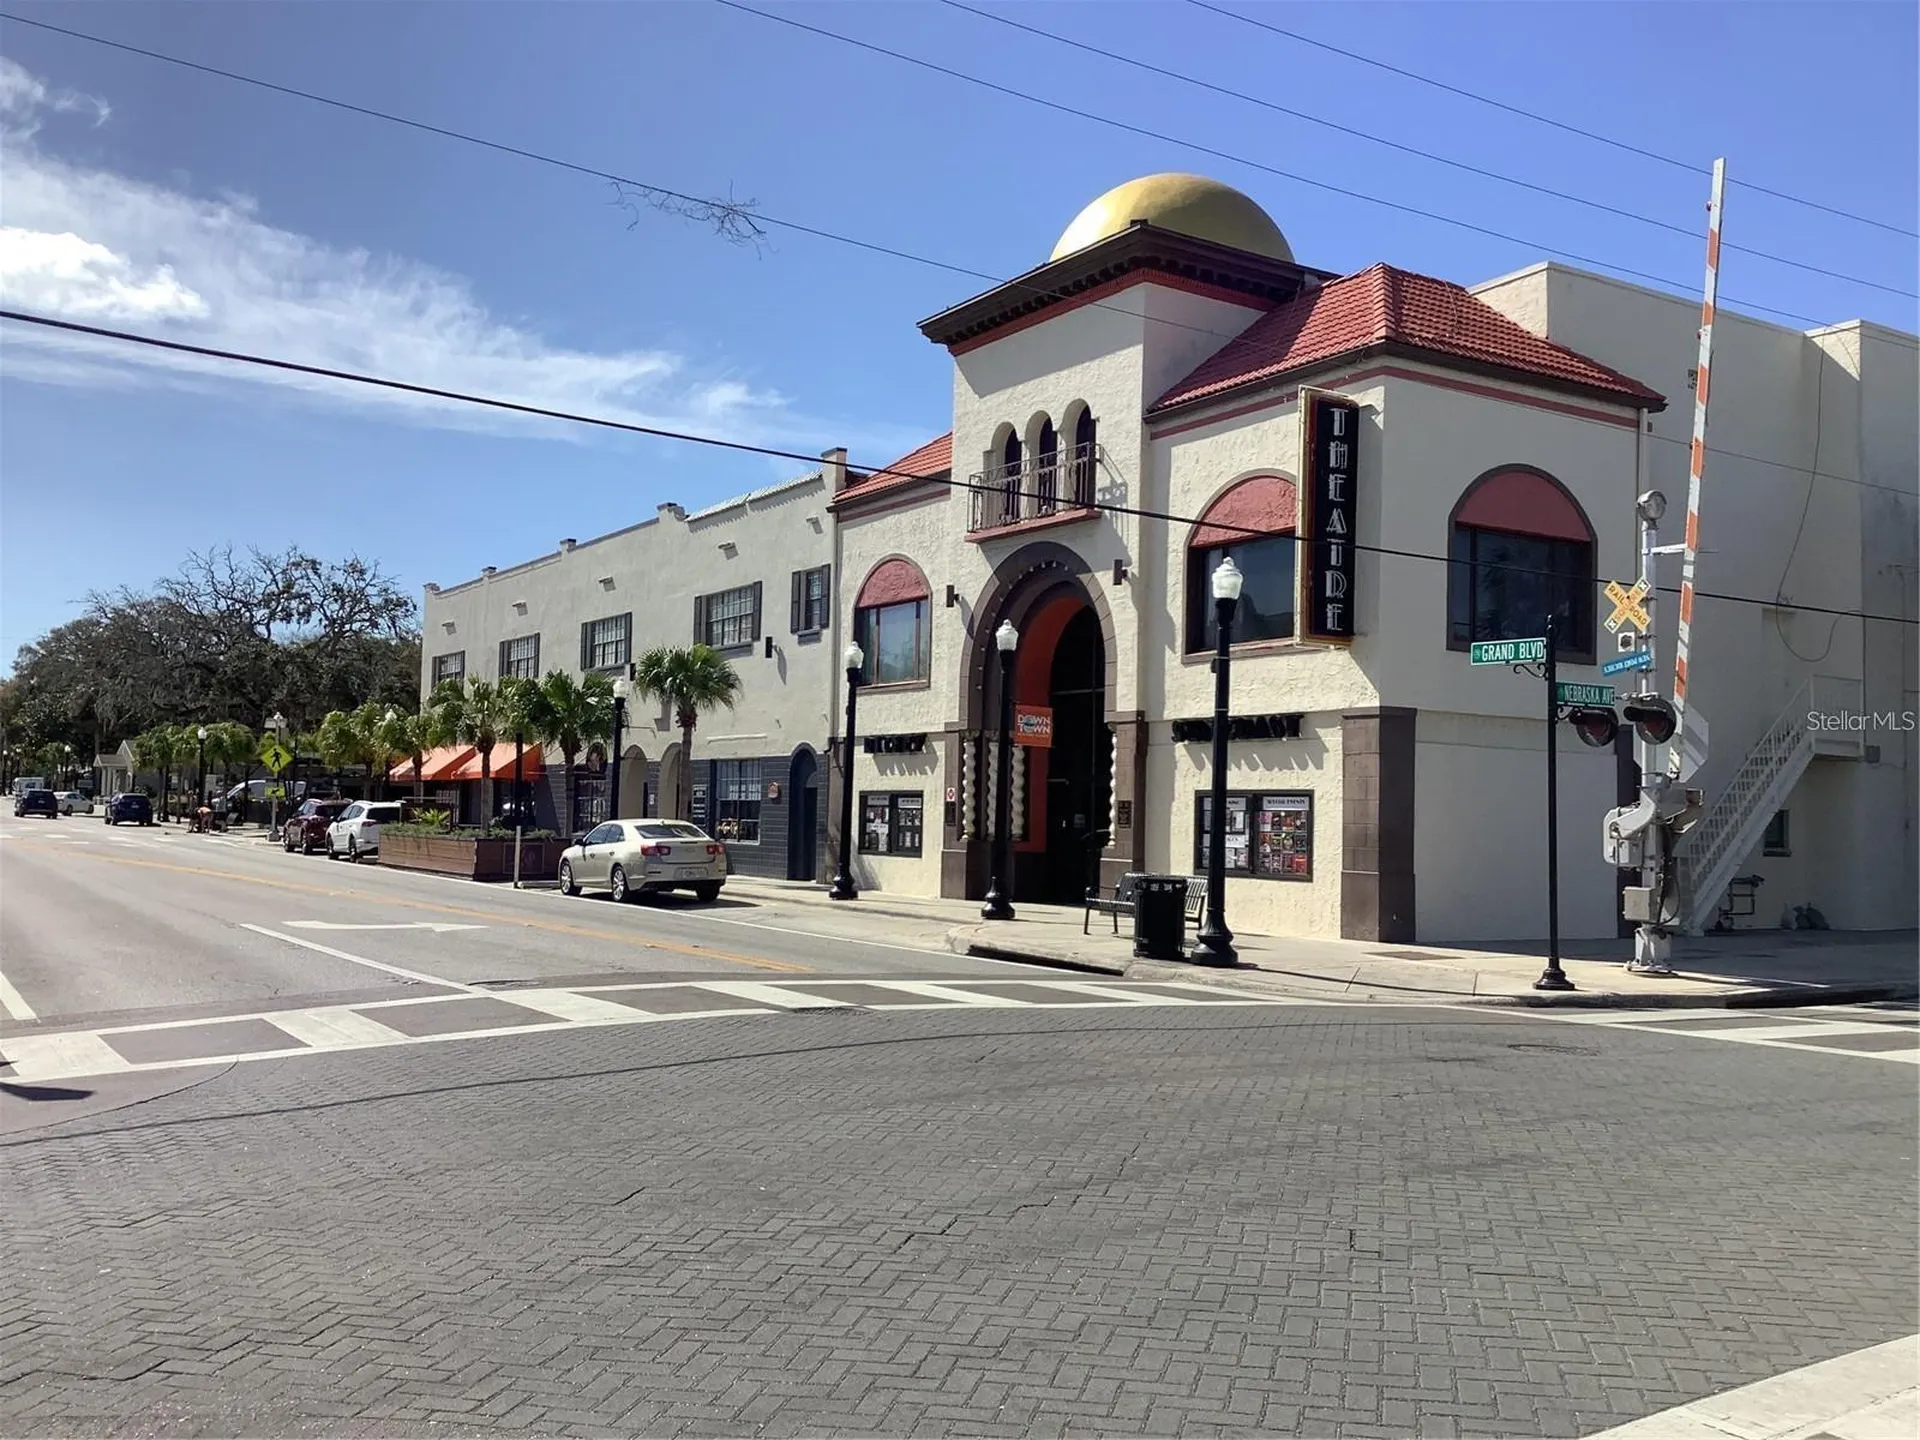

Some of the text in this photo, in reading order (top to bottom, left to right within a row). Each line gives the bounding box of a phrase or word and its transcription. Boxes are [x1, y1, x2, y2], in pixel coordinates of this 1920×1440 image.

[1325, 408, 1349, 631] THEATRE
[1482, 643, 1514, 661] GRAND
[1520, 641, 1544, 659] BLVD
[1564, 685, 1614, 704] NEBRASKA AVE
[1017, 714, 1051, 725] DOWN
[1017, 723, 1051, 734] TOWN
